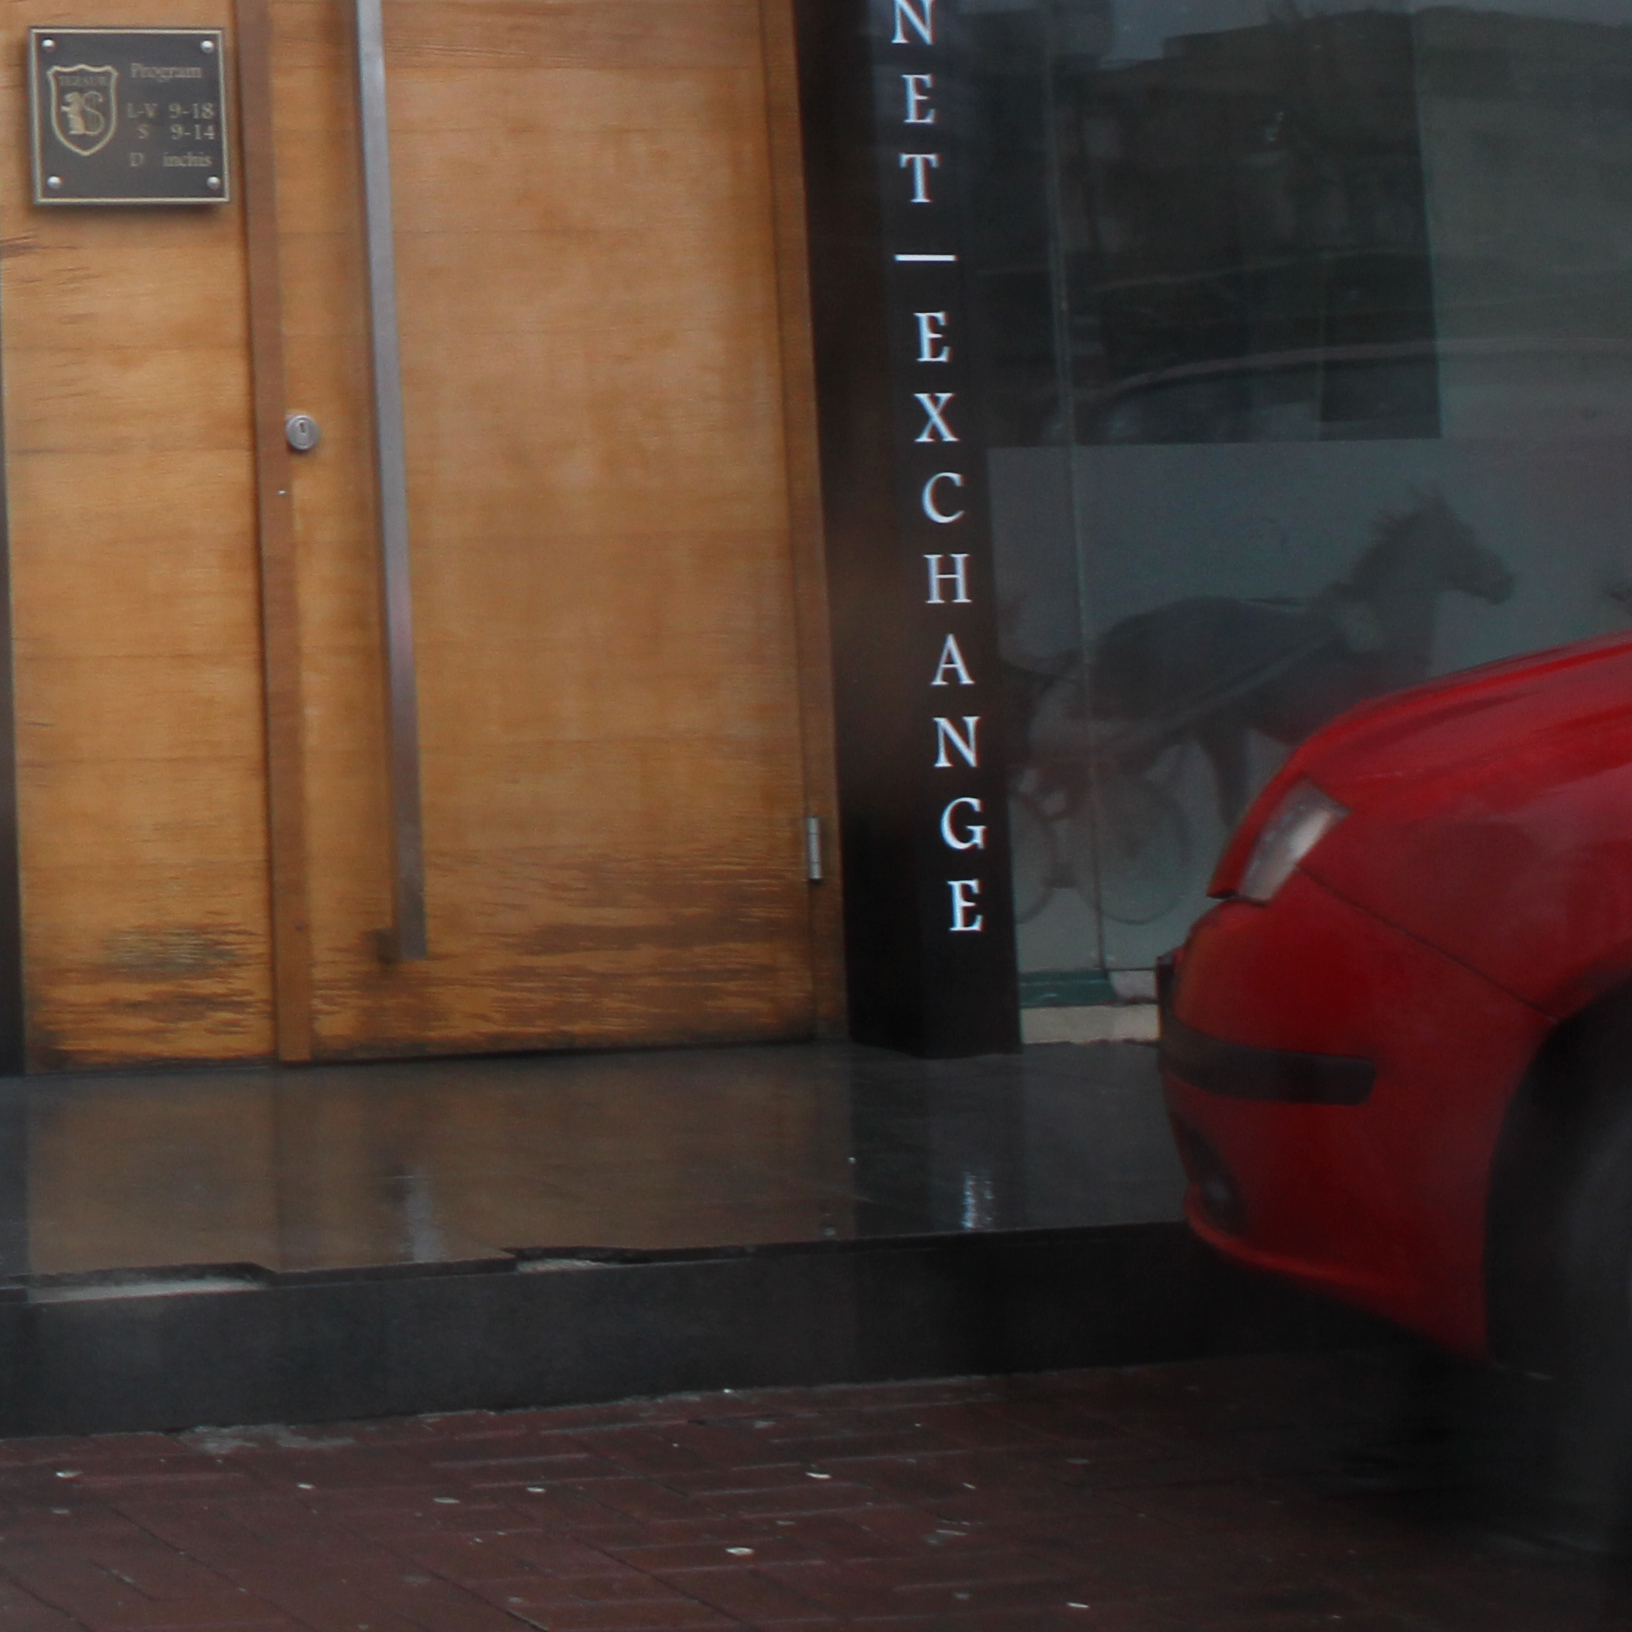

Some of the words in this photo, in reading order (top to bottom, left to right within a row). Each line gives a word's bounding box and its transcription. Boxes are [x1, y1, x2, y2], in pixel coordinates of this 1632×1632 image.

[131, 63, 202, 82] Program
[167, 102, 215, 119] 9-18
[137, 124, 150, 139] S
[169, 123, 216, 140] 9-14
[162, 151, 213, 167] inchis
[914, 310, 986, 934] EXCHANGE
